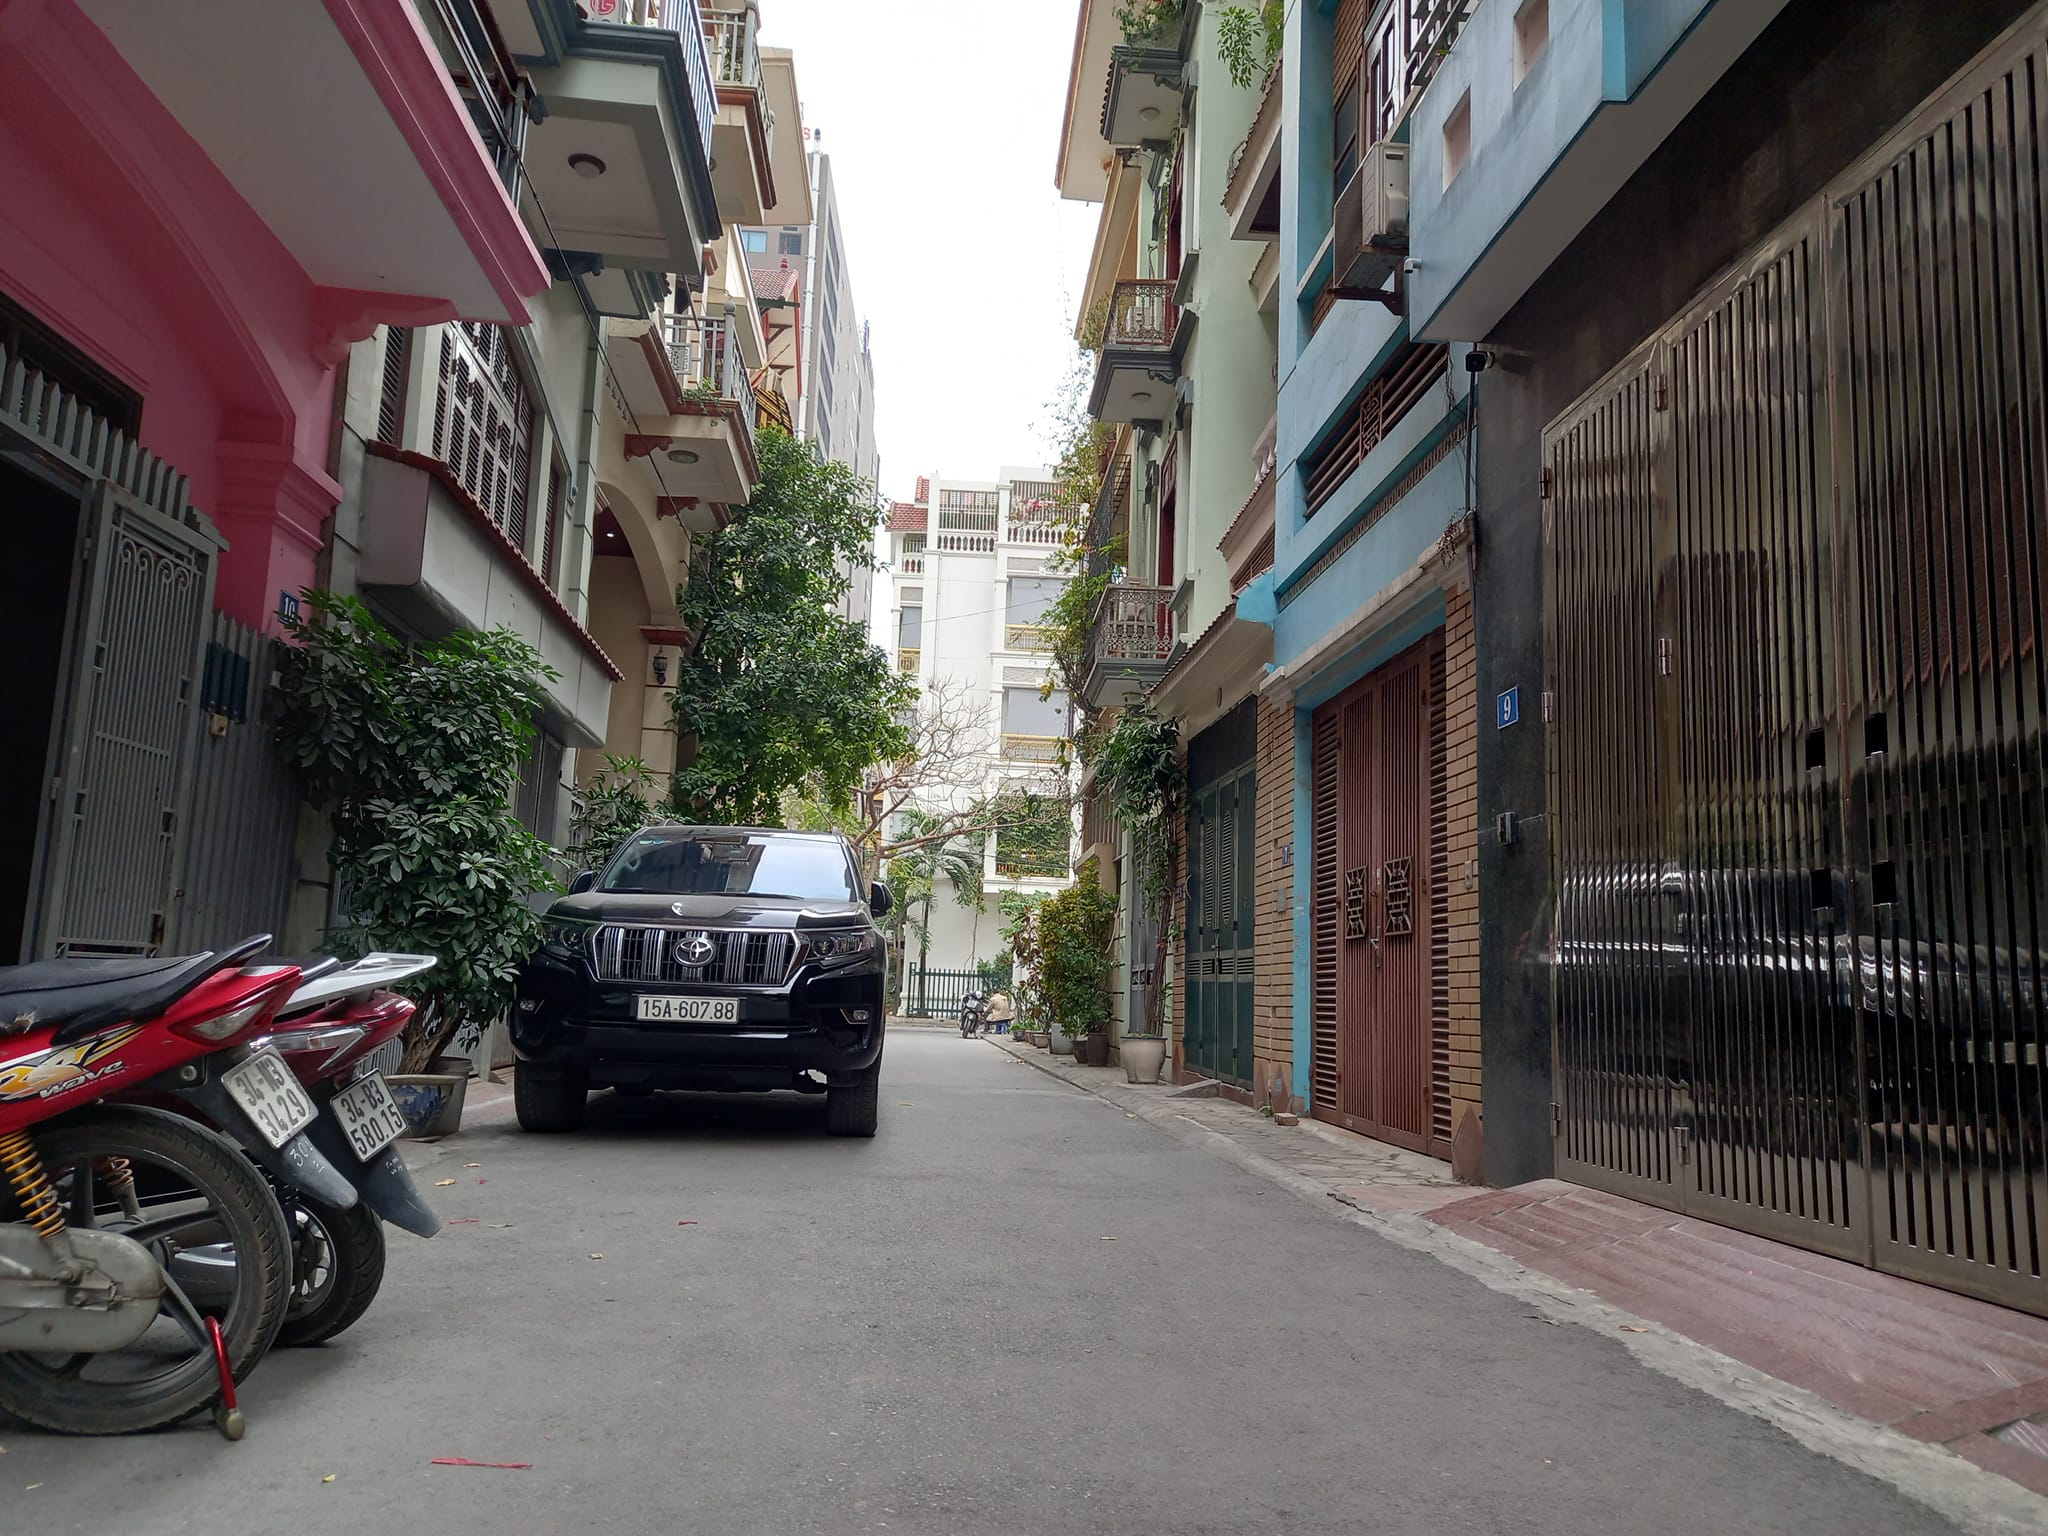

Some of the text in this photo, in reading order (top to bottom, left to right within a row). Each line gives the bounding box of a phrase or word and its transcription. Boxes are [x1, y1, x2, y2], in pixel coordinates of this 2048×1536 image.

[1503, 695, 1511, 721] 9
[643, 999, 735, 1020] 15A-607.88
[257, 1087, 307, 1139] 3429
[340, 1078, 385, 1124] 34-B3
[350, 1102, 403, 1156] 580.15
